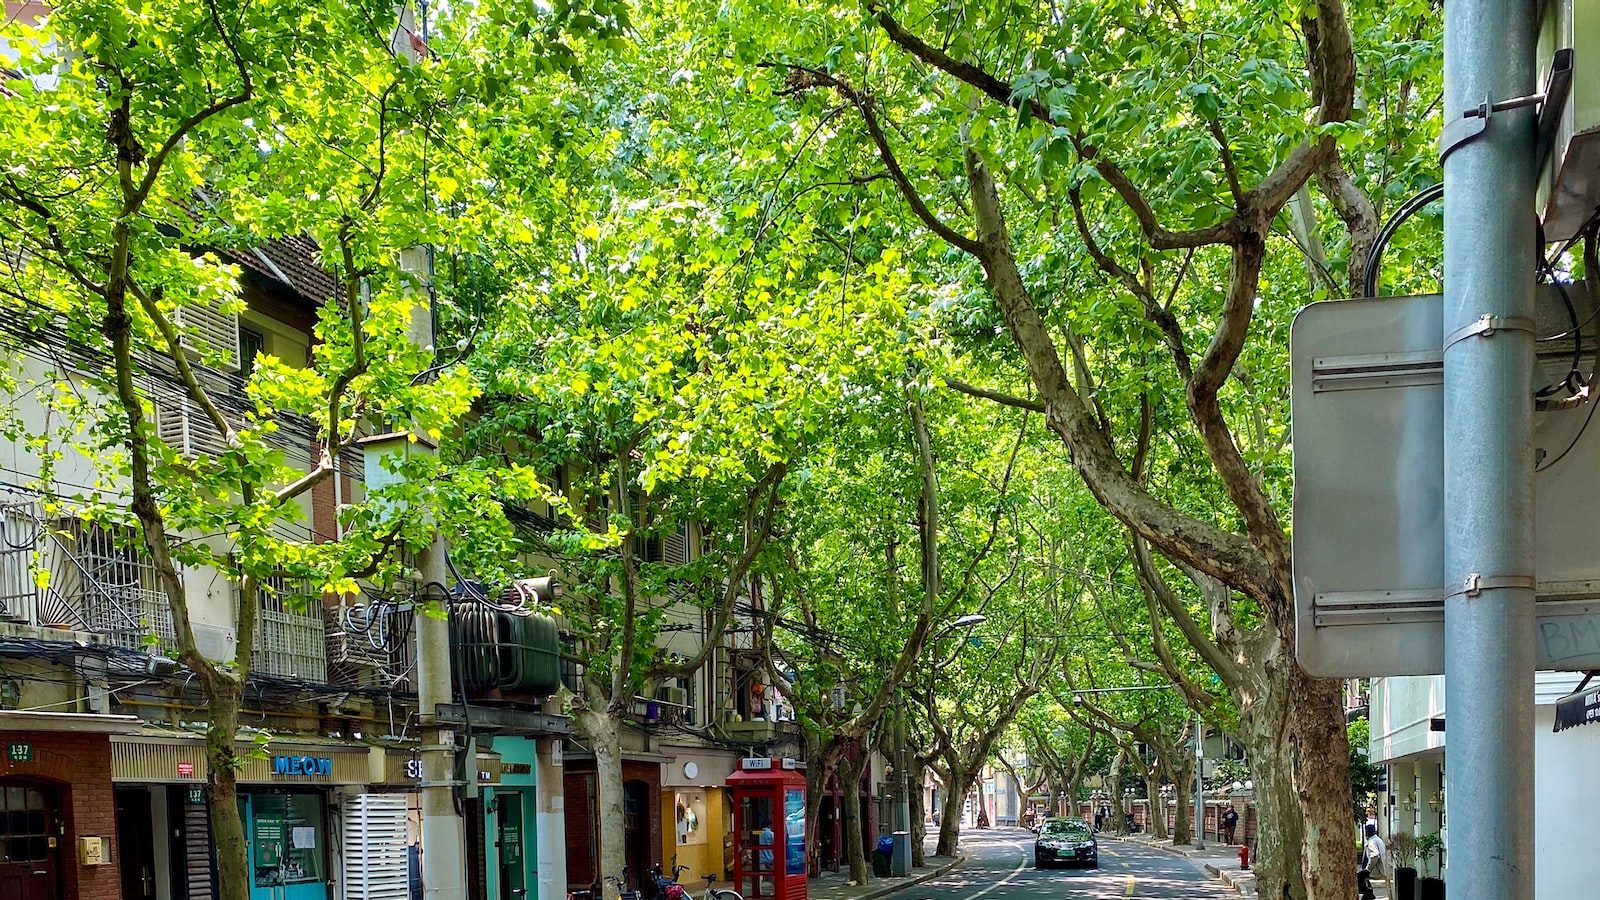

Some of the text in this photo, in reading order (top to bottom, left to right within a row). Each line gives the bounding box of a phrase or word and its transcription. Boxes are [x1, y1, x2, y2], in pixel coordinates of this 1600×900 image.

[11, 745, 29, 755] 137
[275, 756, 332, 776] MEOW
[189, 790, 202, 799] 137
